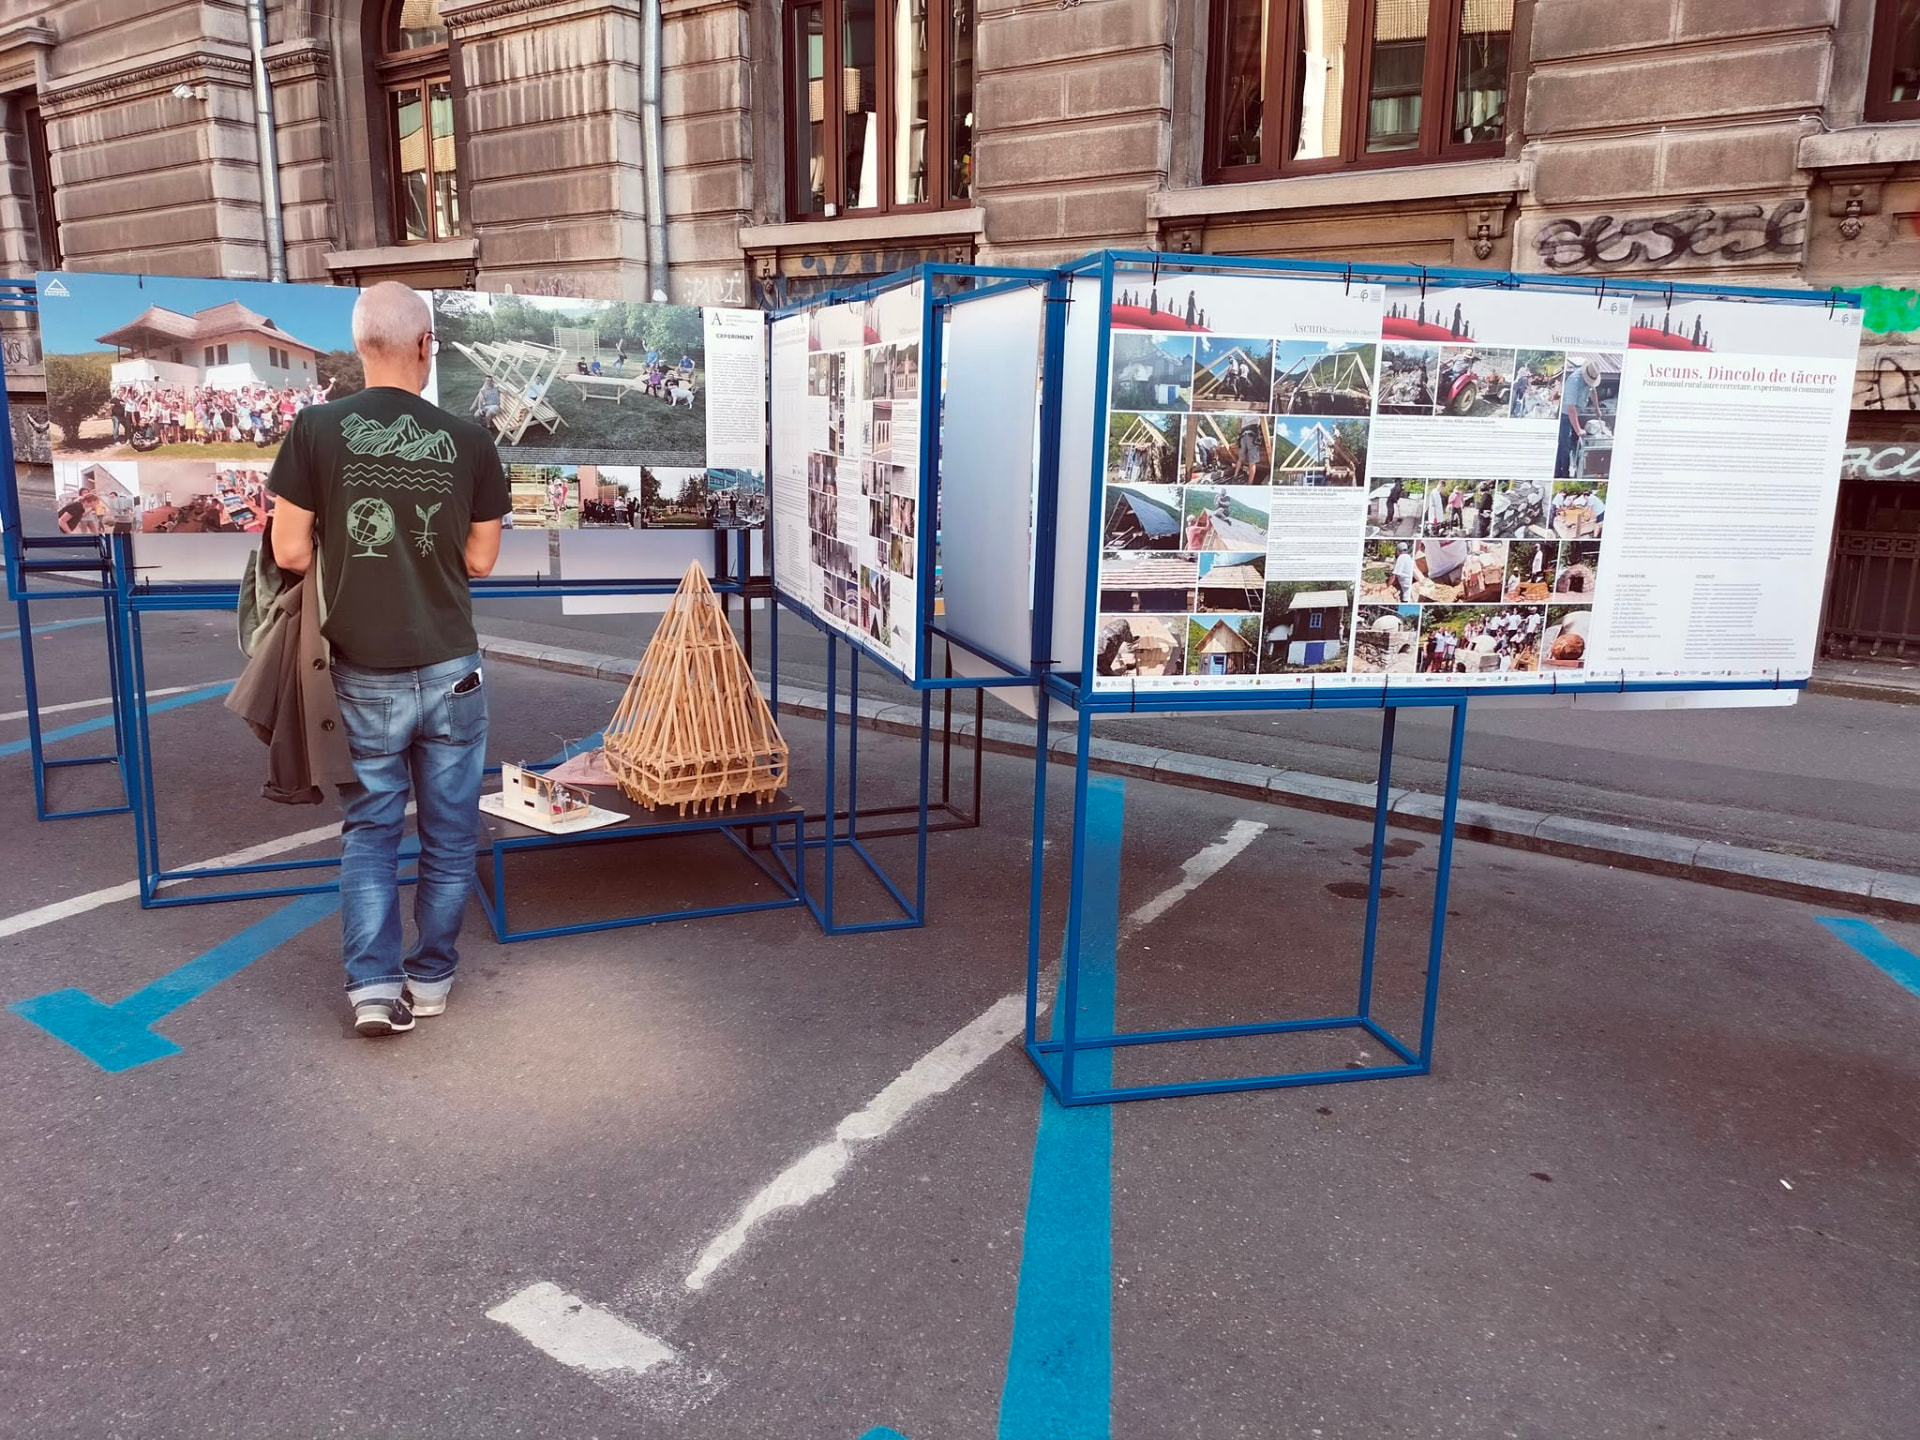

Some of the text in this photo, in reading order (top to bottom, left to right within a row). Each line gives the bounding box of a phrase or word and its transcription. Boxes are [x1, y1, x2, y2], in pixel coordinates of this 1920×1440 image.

[1644, 362, 1837, 386] Ascuns. Dincolo de tăcere
[1684, 380, 1702, 390] rural
[1753, 384, 1791, 393] experiment
